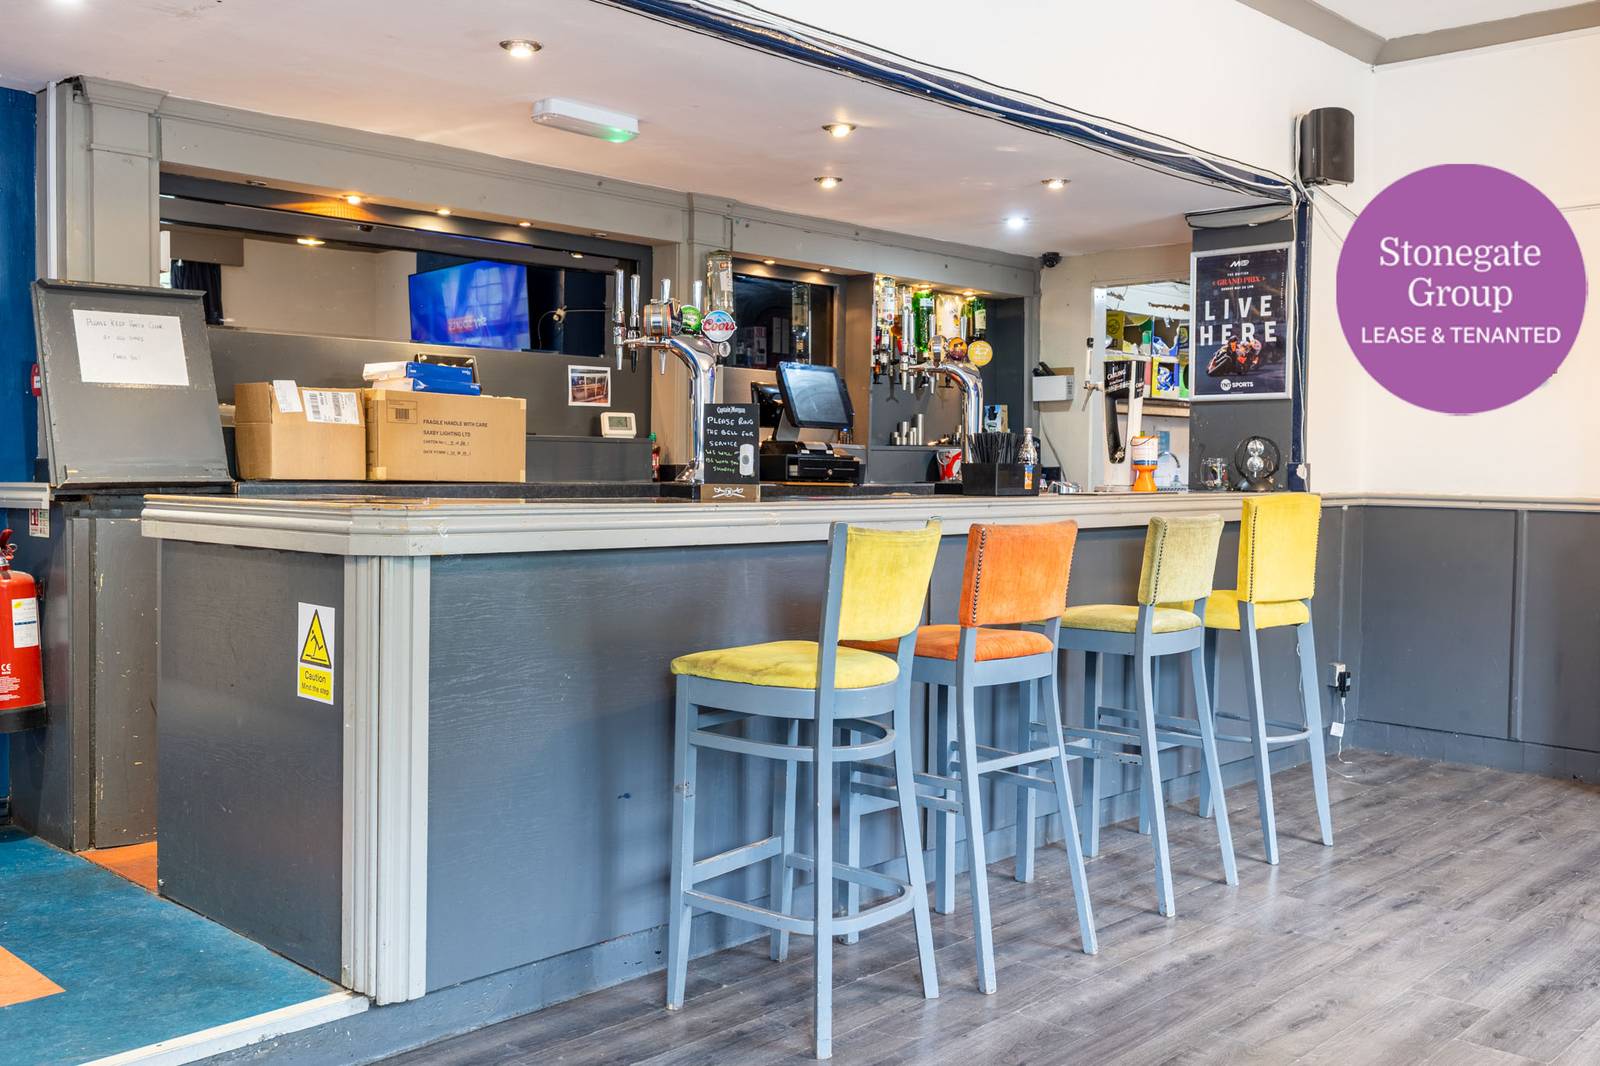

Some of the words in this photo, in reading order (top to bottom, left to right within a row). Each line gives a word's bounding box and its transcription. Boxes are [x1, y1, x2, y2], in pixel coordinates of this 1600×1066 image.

[1217, 277, 1243, 286] GRAND
[1204, 295, 1272, 320] LIVE
[702, 319, 736, 331] Coors
[1200, 321, 1277, 346] HERE
[707, 416, 734, 426] PLEASE
[305, 670, 326, 683] Caution
[302, 682, 312, 690] Mind
